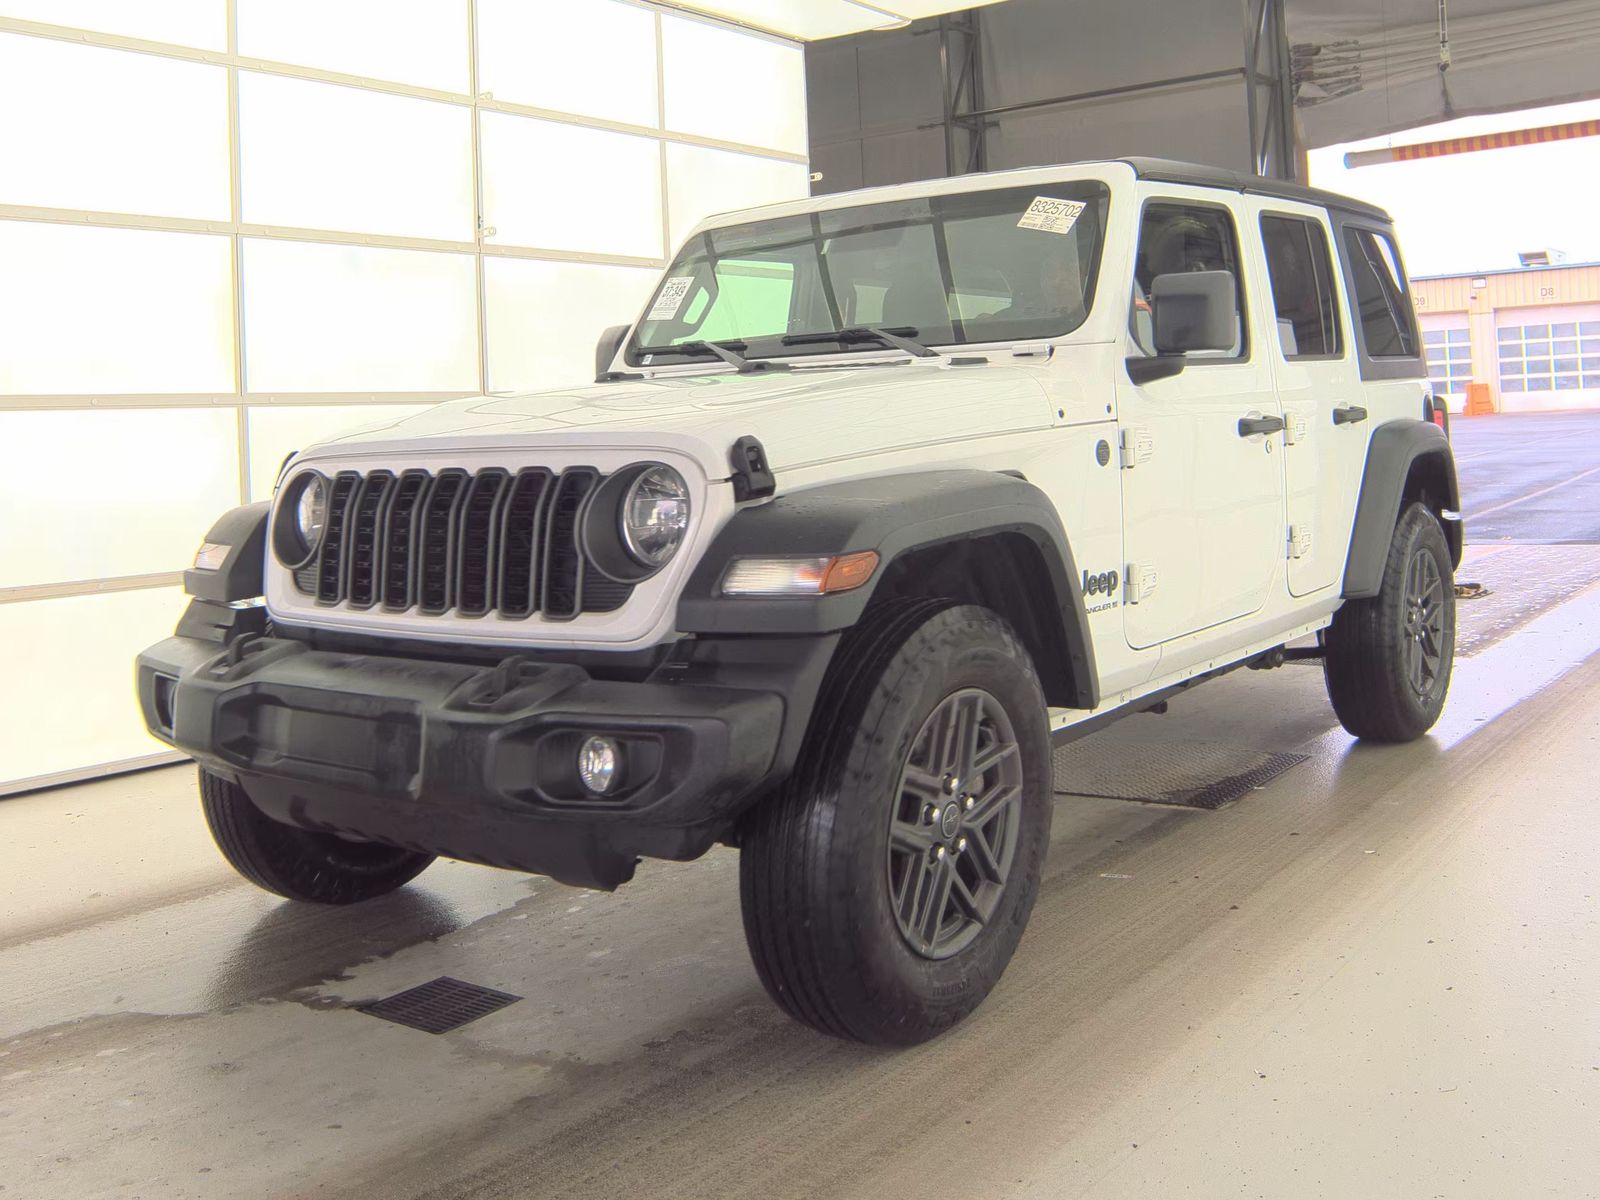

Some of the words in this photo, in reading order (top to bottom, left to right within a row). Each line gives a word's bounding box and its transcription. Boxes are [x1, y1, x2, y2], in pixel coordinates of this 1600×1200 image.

[1031, 200, 1082, 218] 8325702
[1082, 569, 1119, 597] Jeep
[1086, 602, 1112, 614] ANGLER
